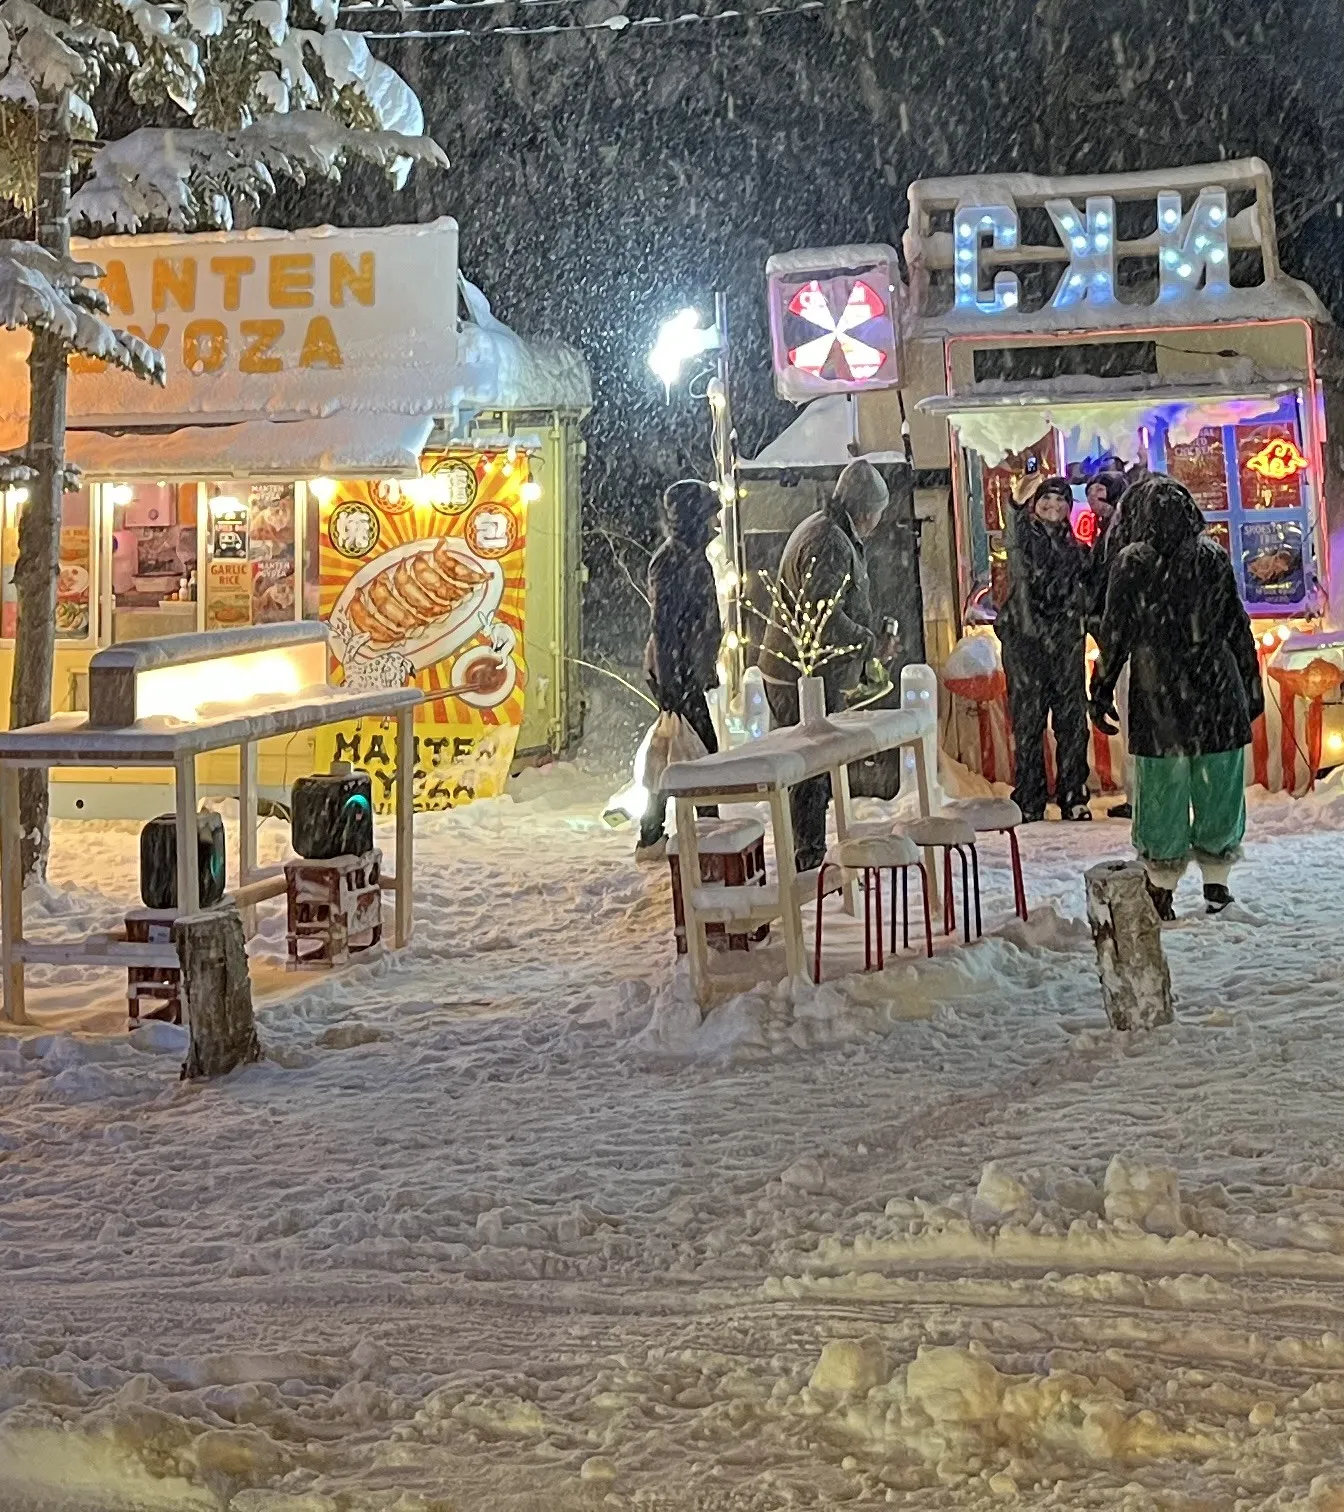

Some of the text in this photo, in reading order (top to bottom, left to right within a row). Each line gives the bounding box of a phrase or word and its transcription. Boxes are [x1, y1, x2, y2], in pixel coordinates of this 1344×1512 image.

[98, 250, 376, 316] ANTEN
[211, 564, 248, 575] GARLIC
[219, 575, 240, 585] RICE
